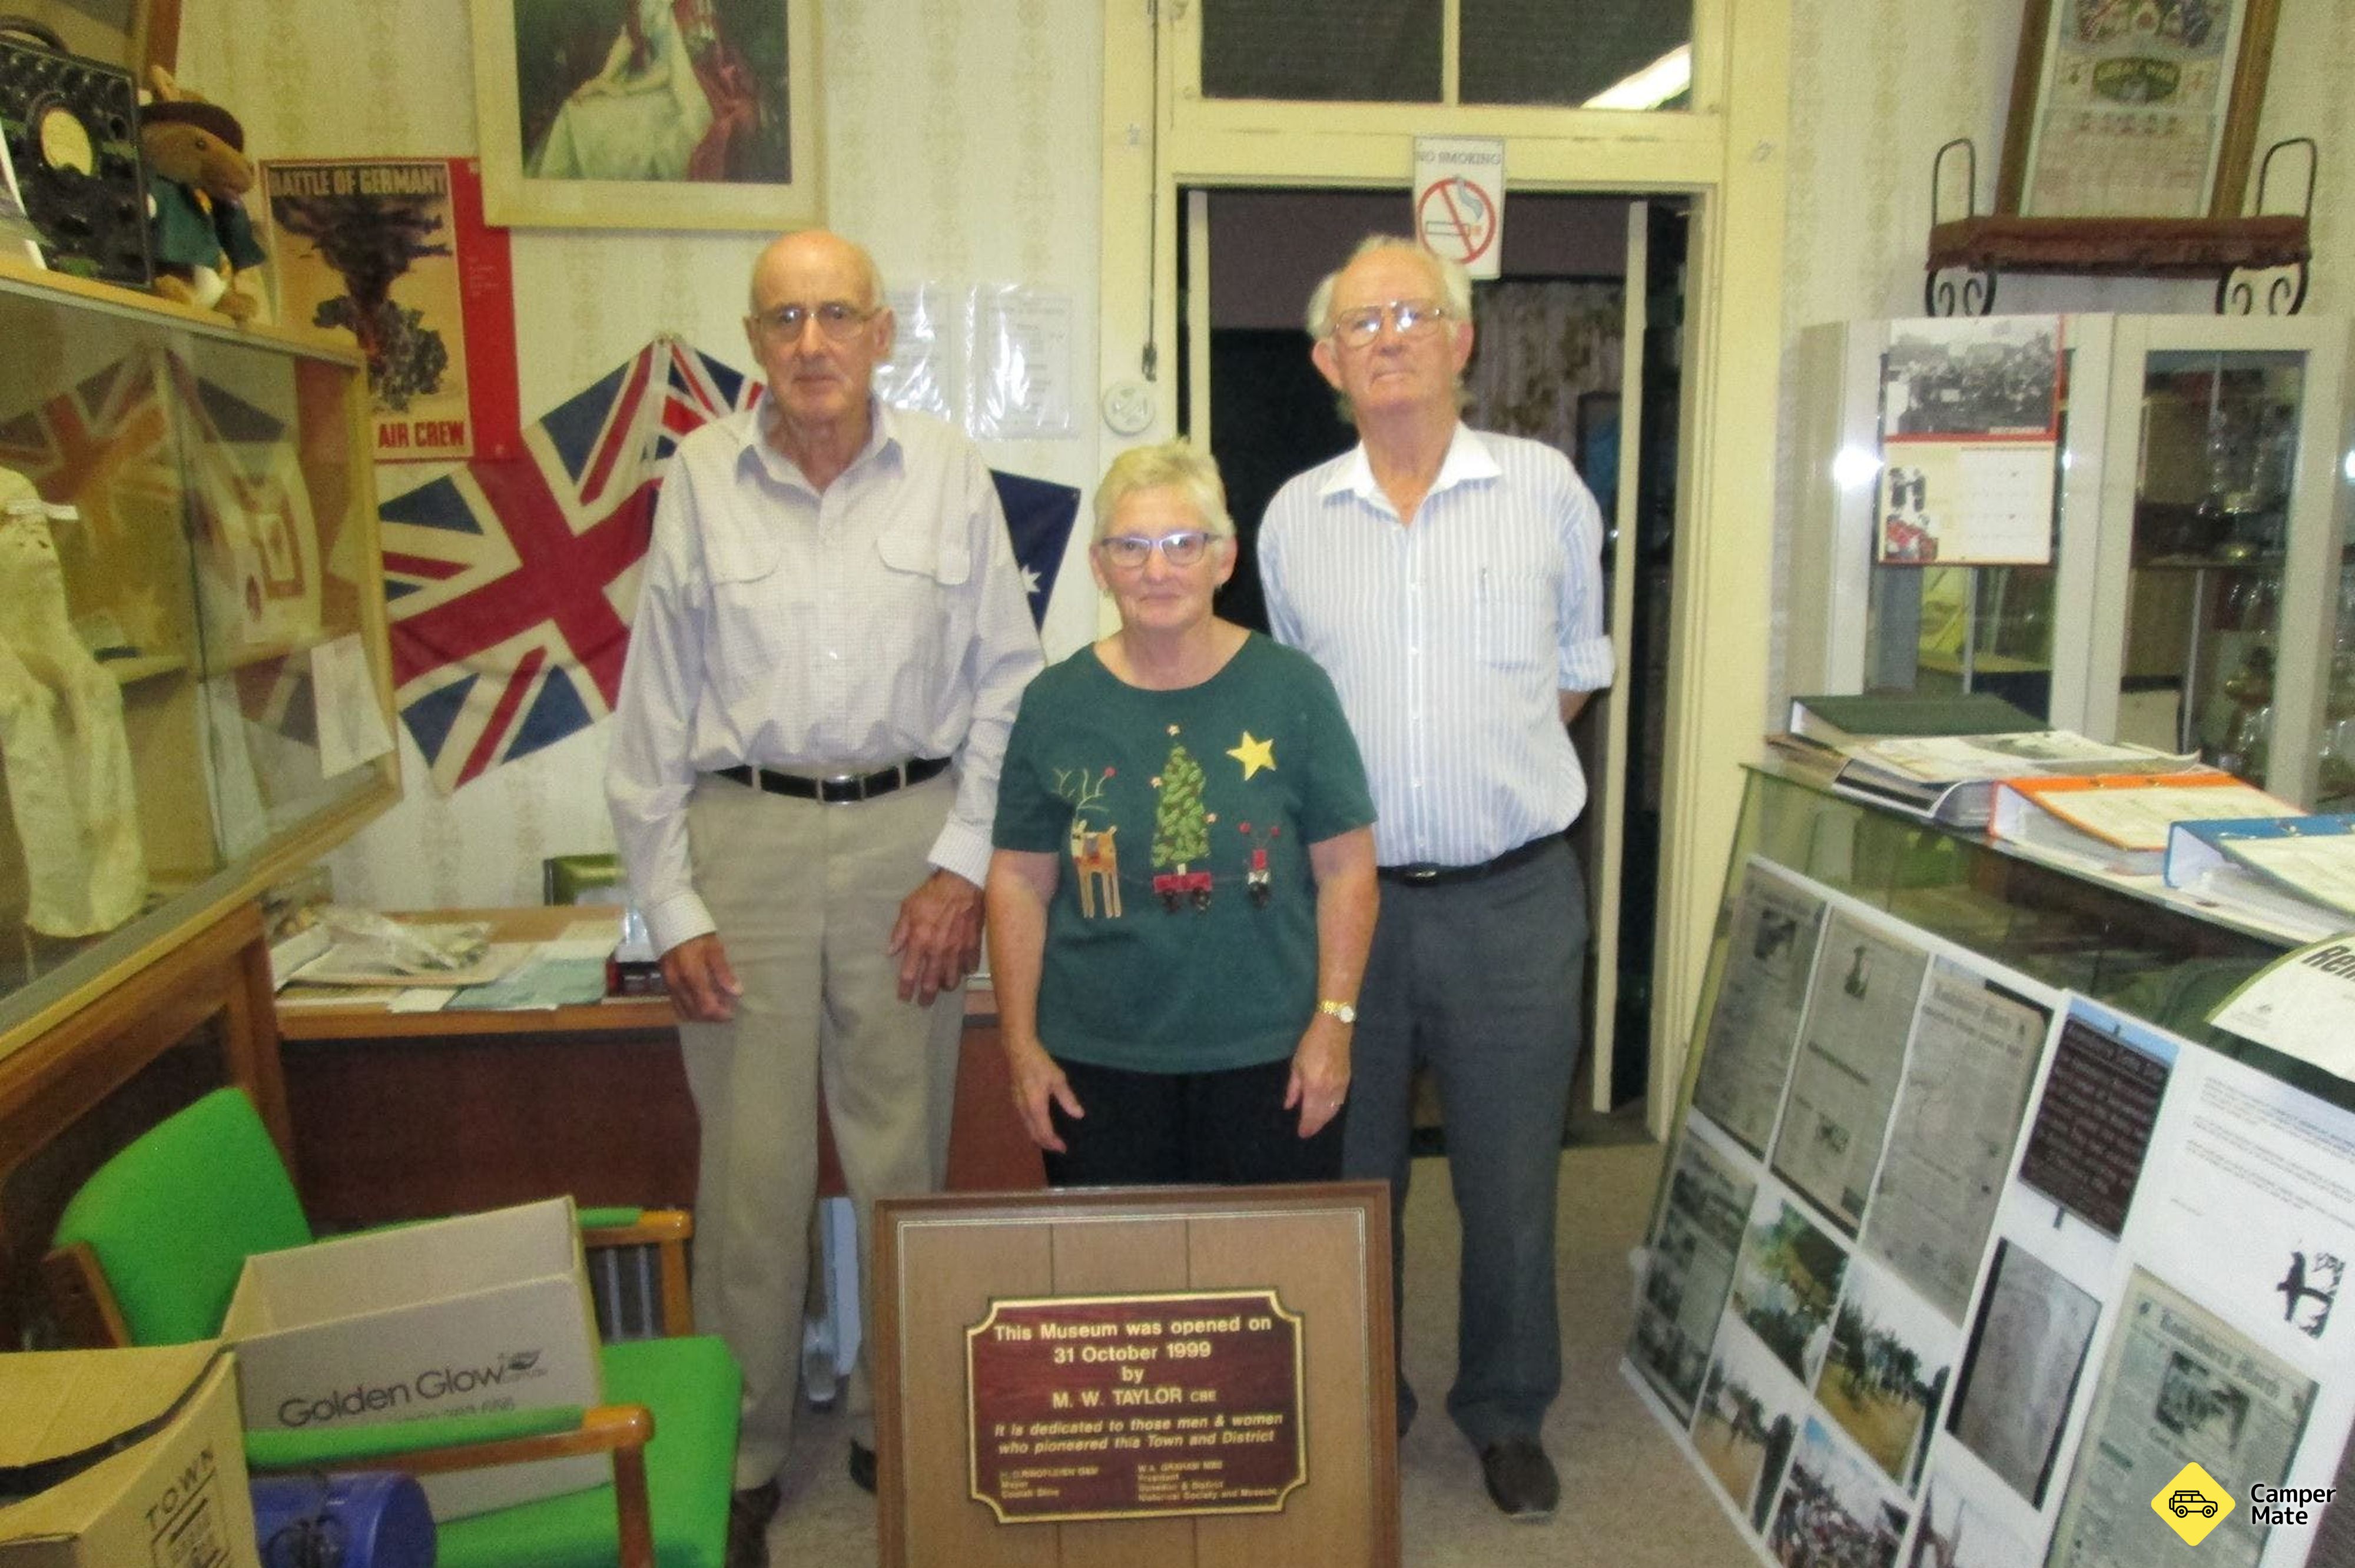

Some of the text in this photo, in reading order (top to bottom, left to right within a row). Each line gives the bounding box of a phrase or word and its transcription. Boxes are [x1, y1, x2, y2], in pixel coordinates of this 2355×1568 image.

[1415, 151, 1501, 165] NO SMOKING
[269, 169, 330, 195] BATTLE
[333, 169, 355, 194] OF
[378, 420, 465, 448] AIR CREW
[993, 1314, 1272, 1341] This Museum was opened on
[1054, 1341, 1212, 1364] 31 October 1999
[1122, 1366, 1144, 1384] by
[278, 1383, 410, 1427] Golden
[416, 1364, 504, 1399] Glow
[1053, 1391, 1073, 1409] M.
[1081, 1390, 1104, 1407] W.
[1112, 1386, 1183, 1406] TAYLOR
[994, 1414, 1283, 1437] It is dedicated to those men & women
[999, 1429, 1275, 1456] who pioneered this Town and District
